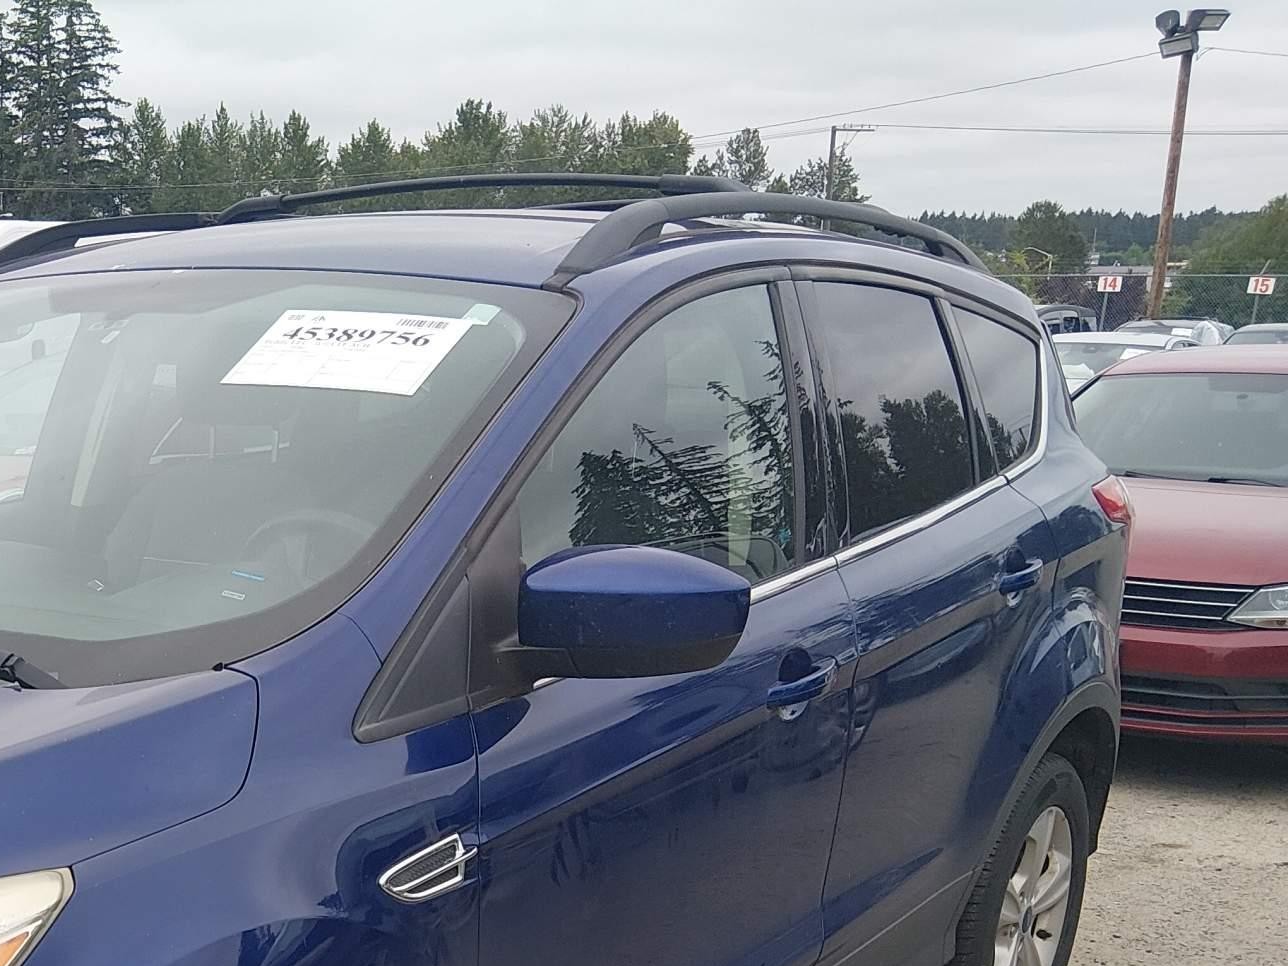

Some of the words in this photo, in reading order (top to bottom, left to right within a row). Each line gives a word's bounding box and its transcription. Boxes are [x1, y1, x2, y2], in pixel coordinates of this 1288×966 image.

[1102, 277, 1118, 291] 14
[1253, 278, 1271, 293] 15
[282, 326, 433, 347] 45389756
